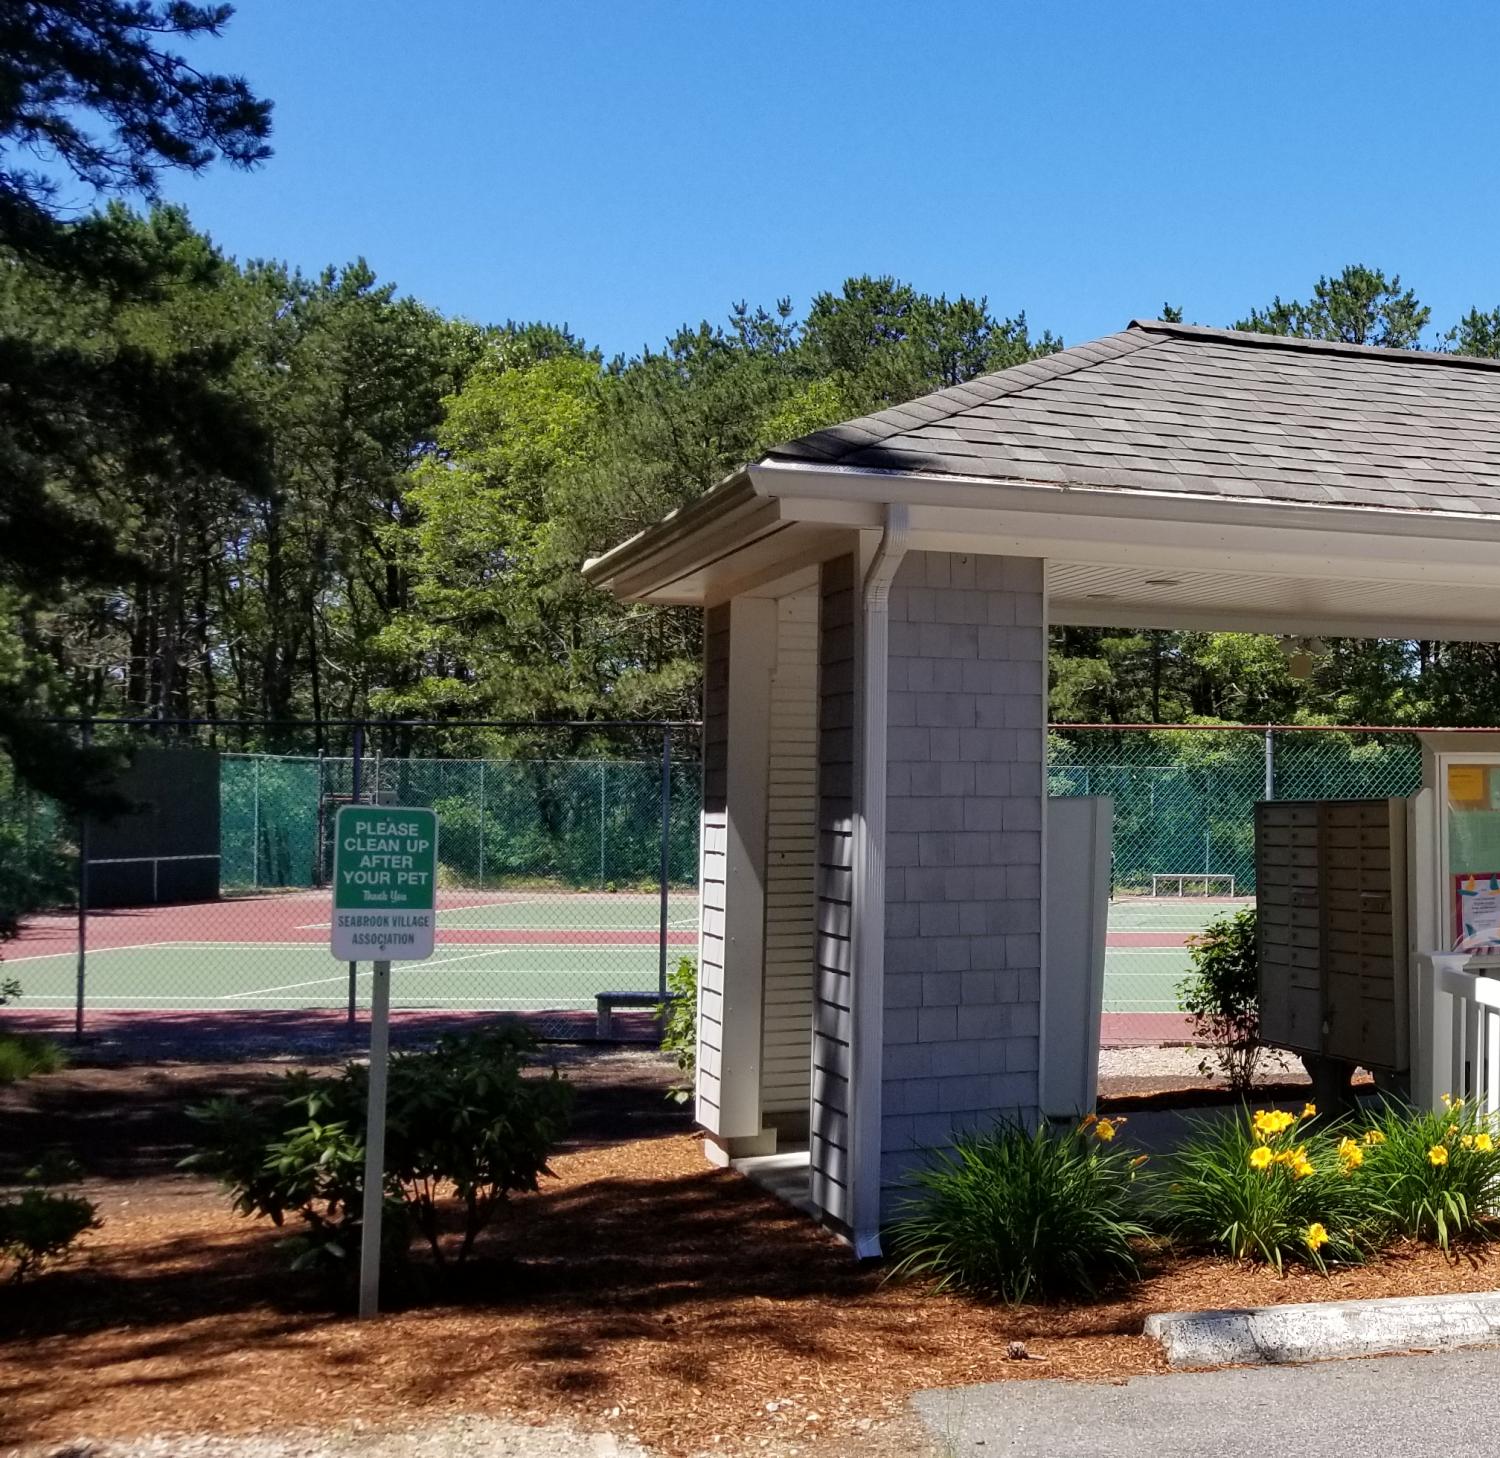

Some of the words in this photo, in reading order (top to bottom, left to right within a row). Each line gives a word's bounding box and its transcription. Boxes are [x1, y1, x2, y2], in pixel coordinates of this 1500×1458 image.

[355, 822, 419, 836] PLEASE
[343, 838, 399, 852] CLEAN
[406, 840, 429, 852] UP
[360, 855, 413, 868] AFTER
[343, 871, 391, 884] YOUR
[397, 872, 428, 885] PET
[362, 890, 388, 901] Thank
[390, 890, 407, 903] You
[338, 915, 389, 927] SEABROOK
[391, 916, 429, 927] VILLAGE
[351, 933, 414, 945] ASSOCIATION
